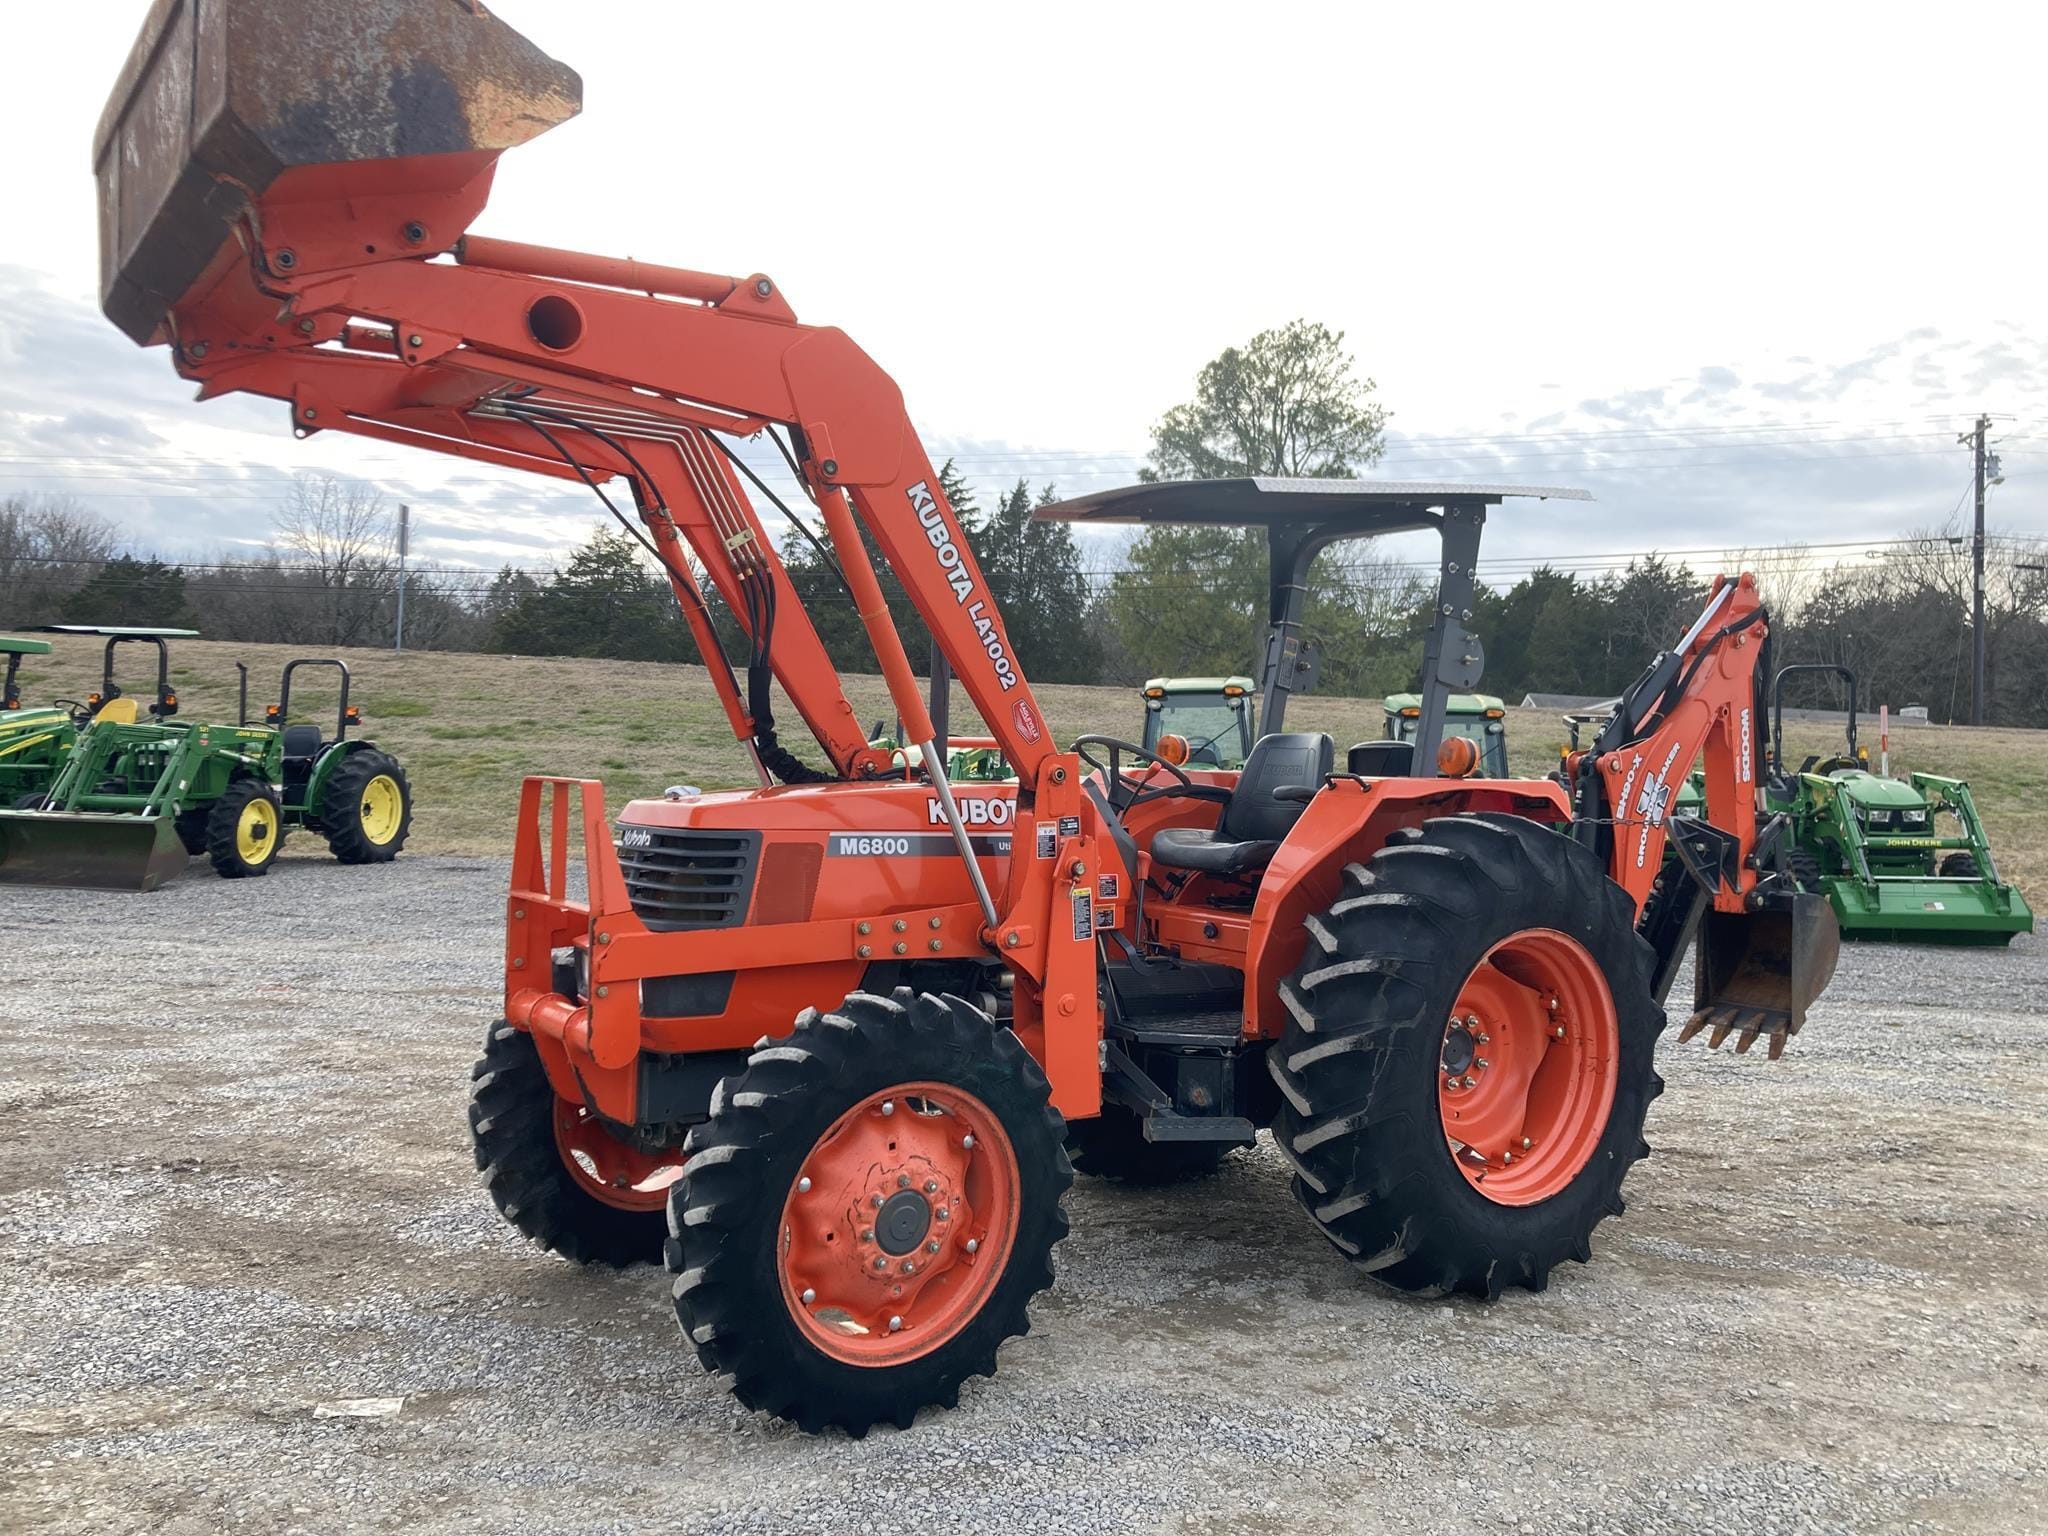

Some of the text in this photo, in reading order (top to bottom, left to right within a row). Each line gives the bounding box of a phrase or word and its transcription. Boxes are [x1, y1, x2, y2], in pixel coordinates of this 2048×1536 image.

[906, 480, 1018, 692] KUBOTA LA1002
[1740, 707, 1751, 783] WOODS
[1615, 752, 1643, 820] BH90-X
[1636, 741, 1681, 869] GROUNDBREAKER
[623, 830, 651, 847] Kubota
[840, 838, 909, 855] M6800
[1886, 839, 1942, 848] JOHN DEERE
